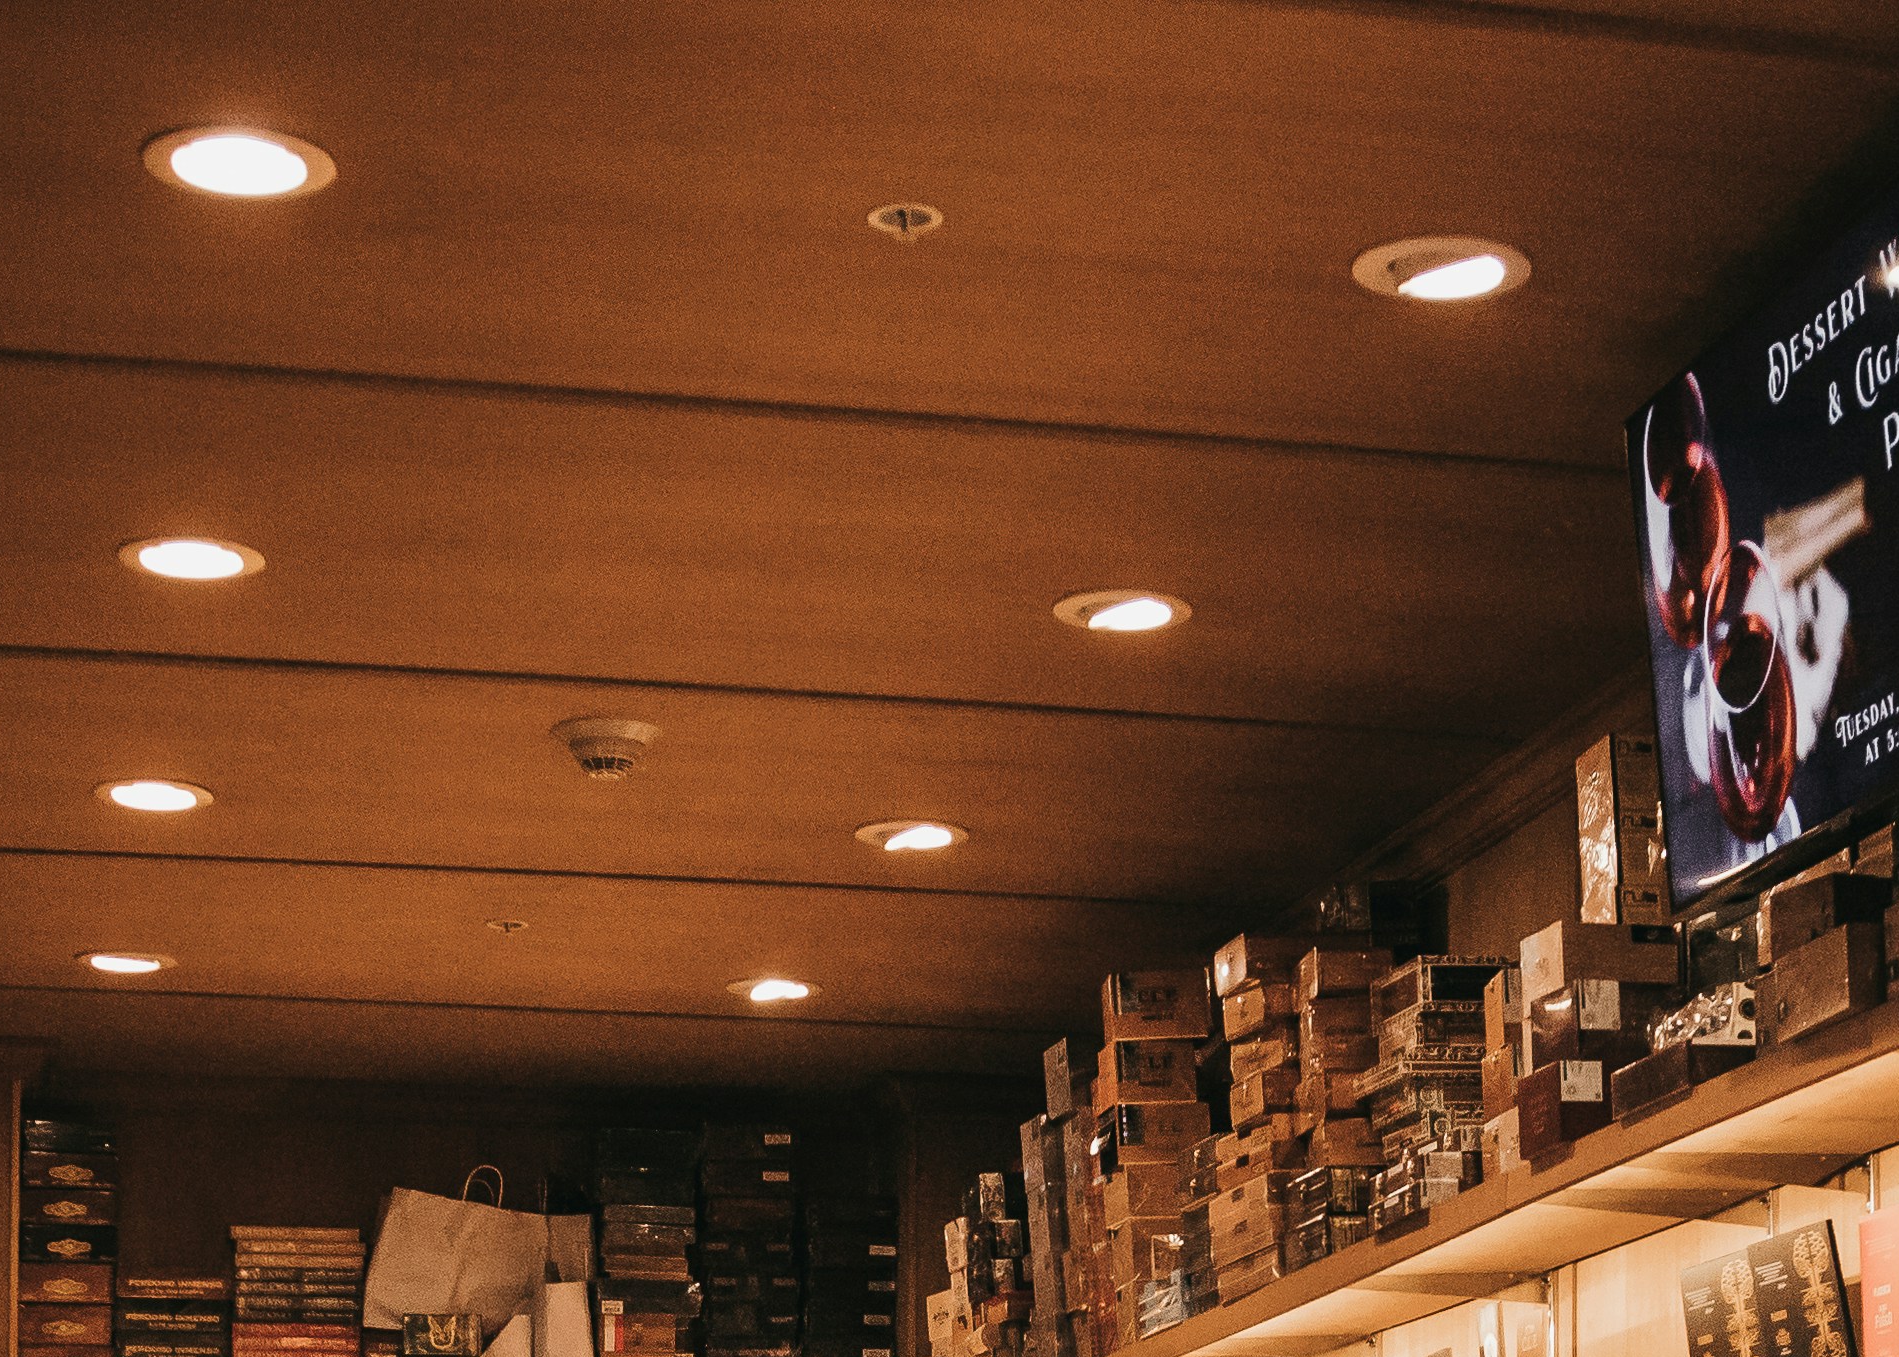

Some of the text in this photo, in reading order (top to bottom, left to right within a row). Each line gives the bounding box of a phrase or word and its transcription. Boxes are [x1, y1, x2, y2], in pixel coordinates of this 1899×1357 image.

[1767, 275, 1867, 405] DESSERT
[1827, 381, 1843, 426] &
[1835, 694, 1899, 749] TUESDAY,
[1864, 738, 1882, 767] AT
